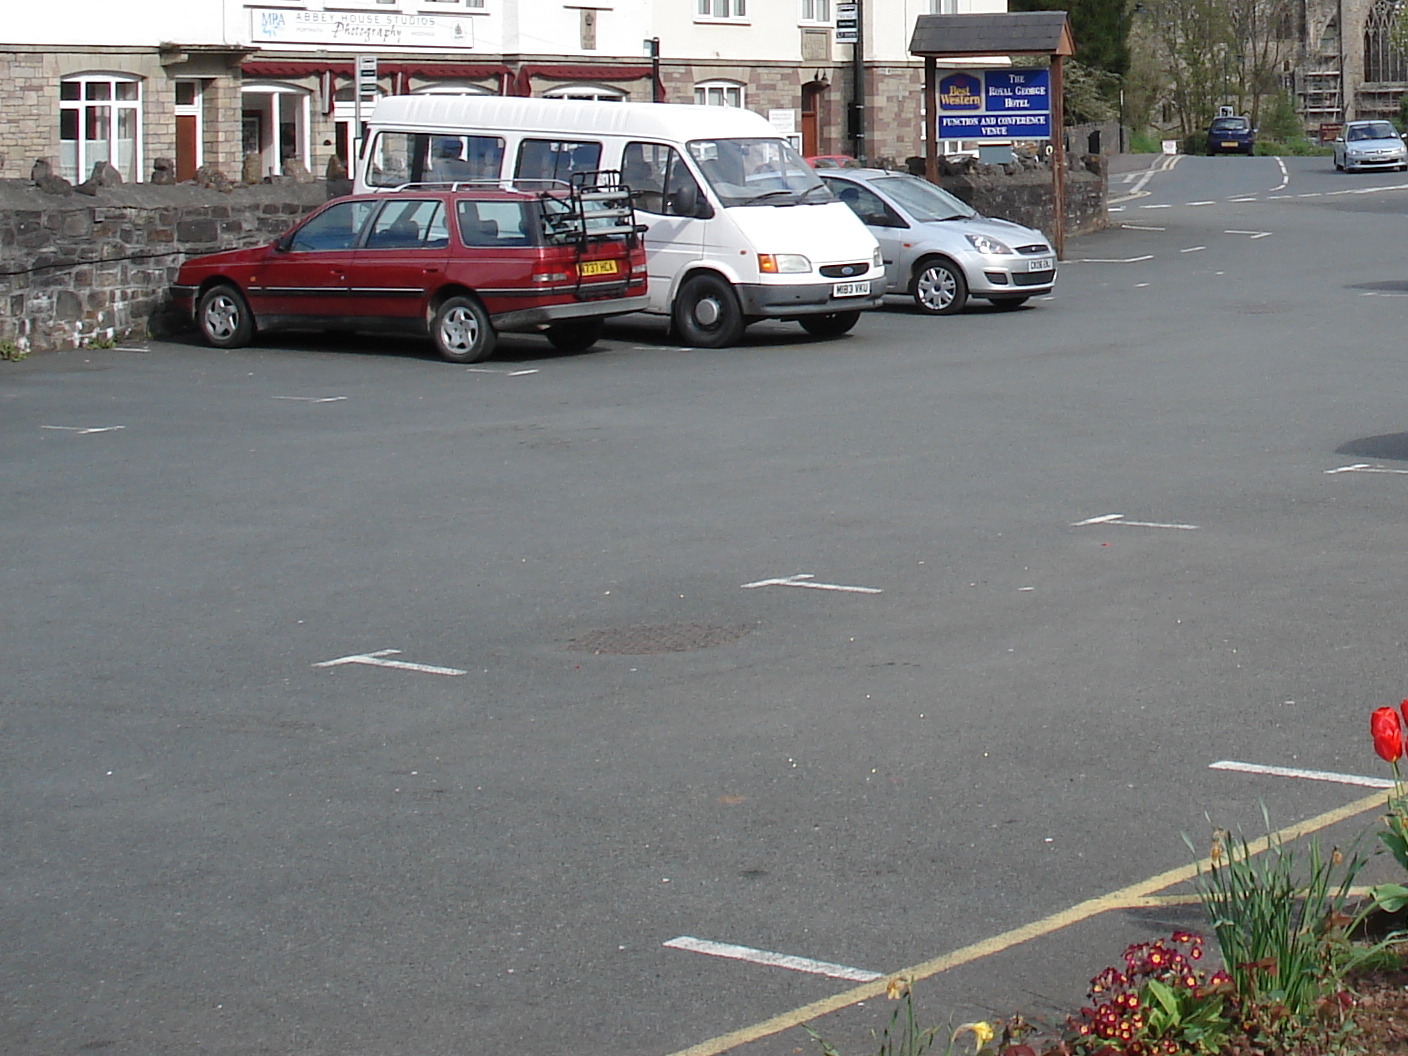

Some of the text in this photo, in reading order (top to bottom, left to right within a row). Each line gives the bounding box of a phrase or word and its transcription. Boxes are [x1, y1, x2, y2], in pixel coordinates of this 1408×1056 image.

[295, 13, 435, 26] ABBEY HOUSE STUDIOS
[332, 21, 402, 43] Photography
[1008, 74, 1025, 83] THE
[949, 85, 970, 96] Best
[988, 85, 1046, 96] ROYAL GEORGE
[940, 94, 980, 105] Western
[1004, 98, 1030, 108] HOTEL
[942, 116, 1046, 126] FUNCTION AND CONFERENCE
[981, 127, 1008, 135] VENUE
